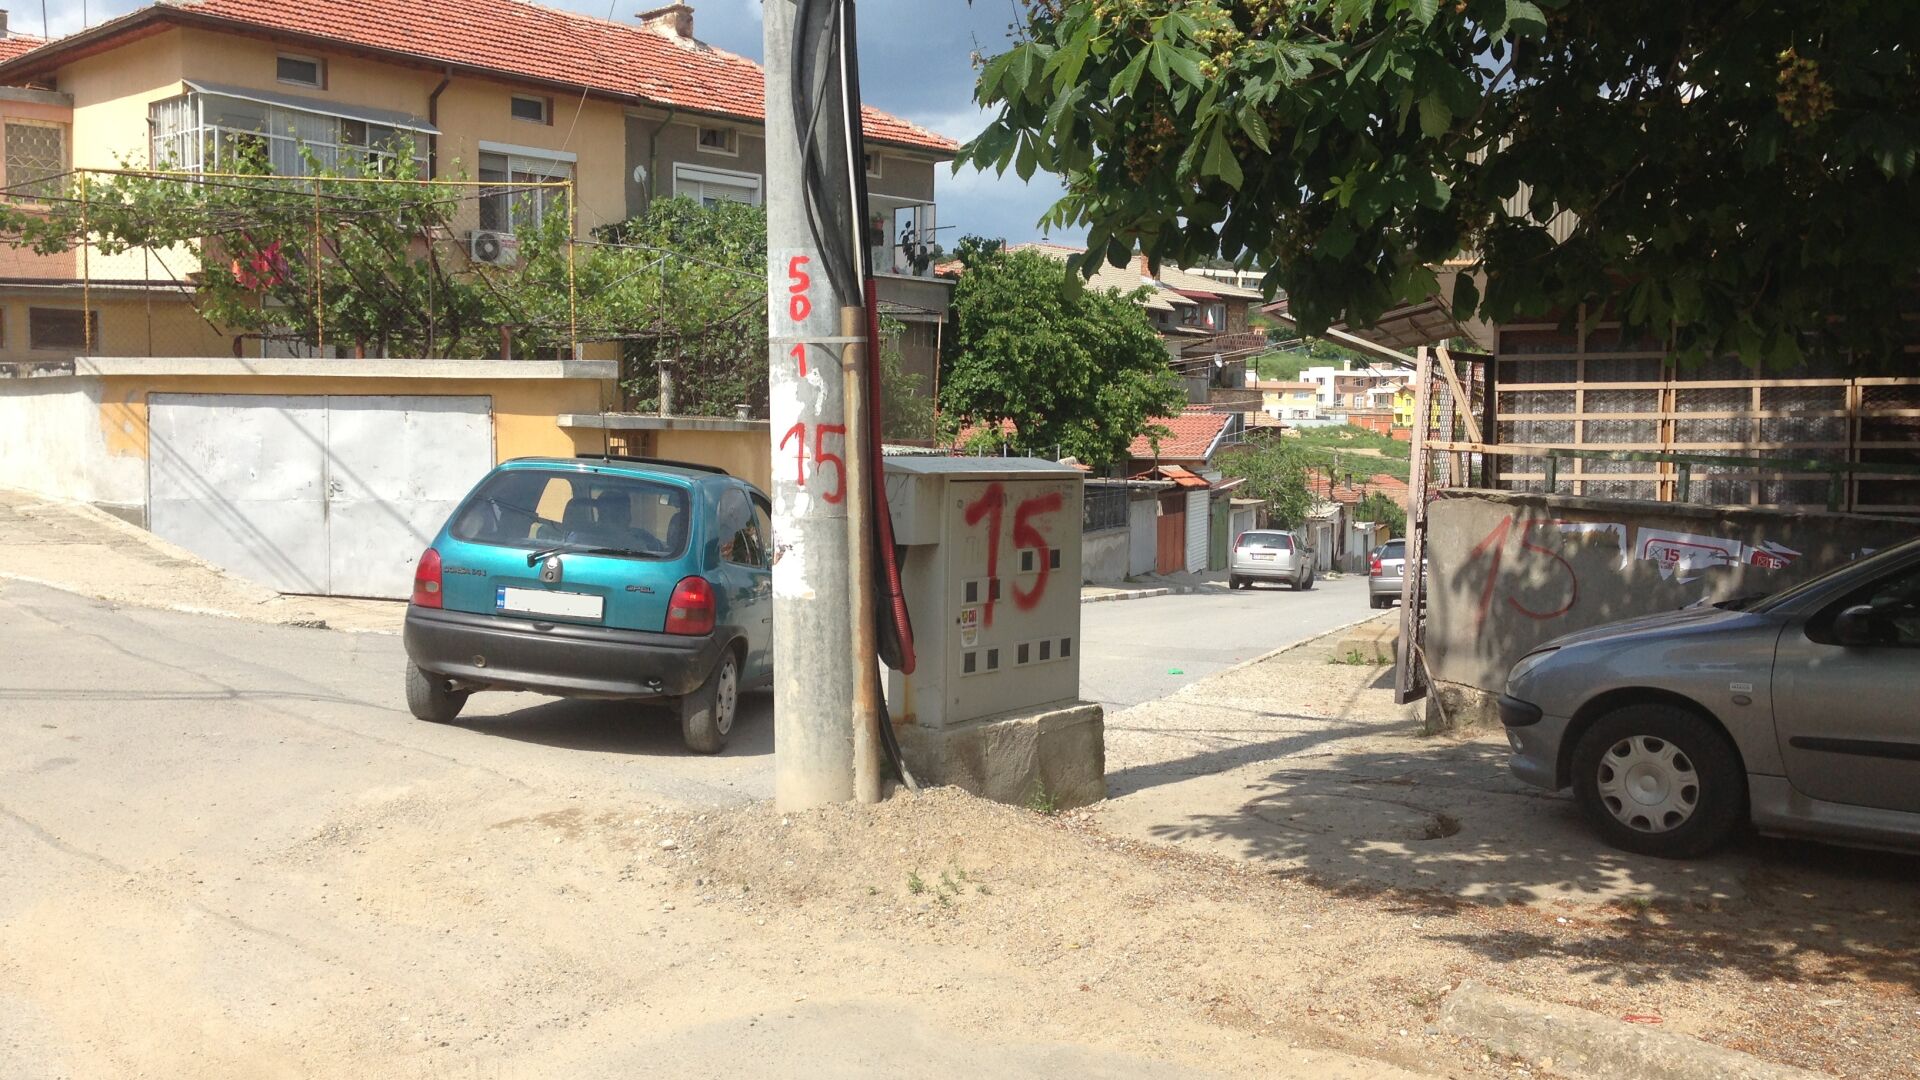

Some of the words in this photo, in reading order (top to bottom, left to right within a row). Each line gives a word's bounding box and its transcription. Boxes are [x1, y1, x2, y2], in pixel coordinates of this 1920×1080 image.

[779, 422, 847, 504] 15
[964, 482, 1063, 628] 15
[1470, 514, 1577, 630] 15
[1664, 547, 1680, 562] 15
[1768, 558, 1782, 569] 15
